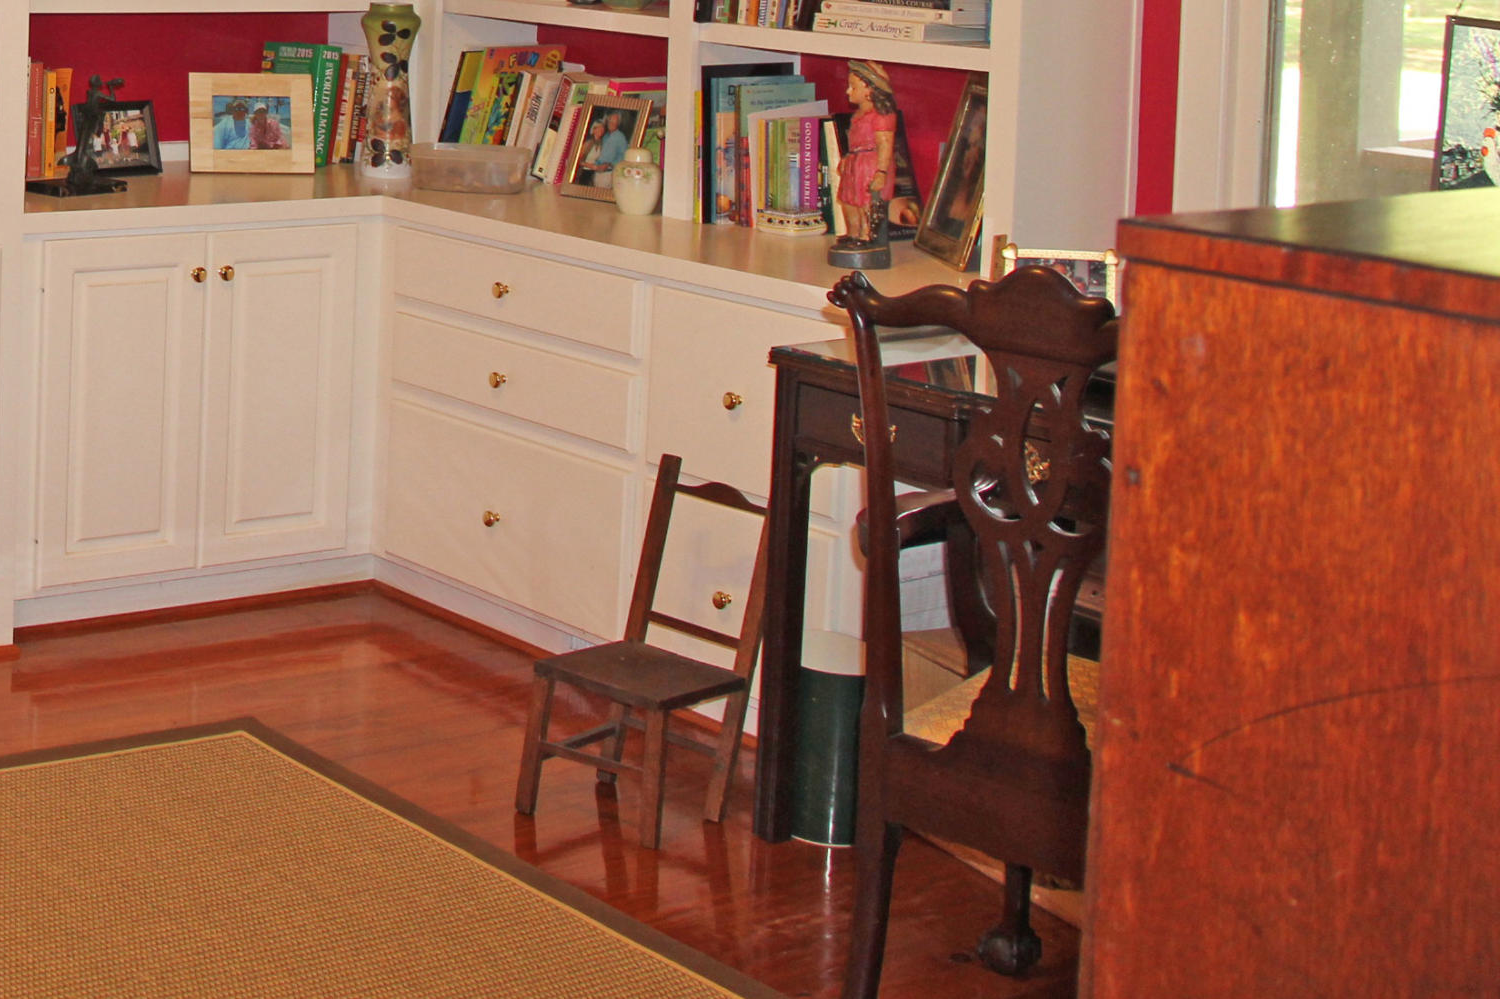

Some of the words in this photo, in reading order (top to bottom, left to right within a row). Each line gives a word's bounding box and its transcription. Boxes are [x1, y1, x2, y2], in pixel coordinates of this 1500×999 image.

[905, 0, 933, 8] COURSE
[839, 19, 861, 30] Craft
[860, 21, 903, 39] Academy
[297, 48, 313, 58] 2015
[322, 50, 339, 60] 2015
[508, 52, 540, 69] FUN
[321, 66, 334, 104] WORLD
[315, 105, 329, 154] ALMANAC
[804, 121, 812, 150] GOOD
[803, 183, 811, 209] BIBLE
